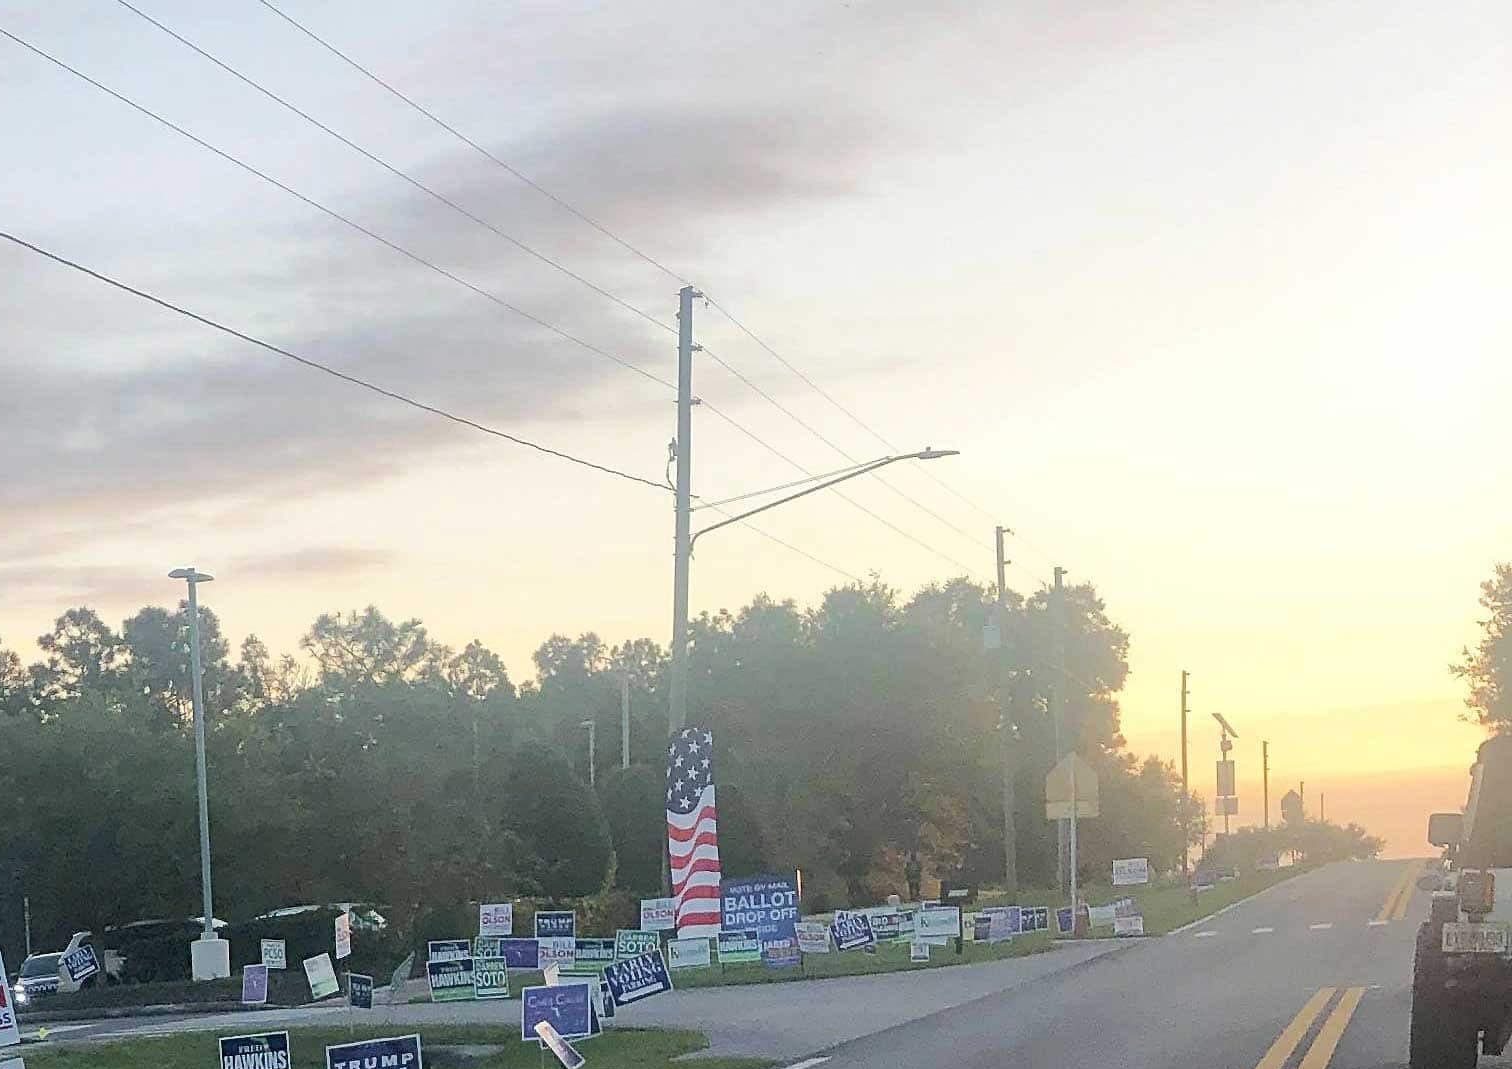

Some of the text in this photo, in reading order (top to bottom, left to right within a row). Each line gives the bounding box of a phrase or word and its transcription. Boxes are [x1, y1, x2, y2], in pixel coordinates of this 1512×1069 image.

[724, 891, 796, 912] BALLOT
[725, 907, 798, 925] DROP OFF
[619, 941, 656, 953] SOTO
[476, 971, 506, 987] SOTO
